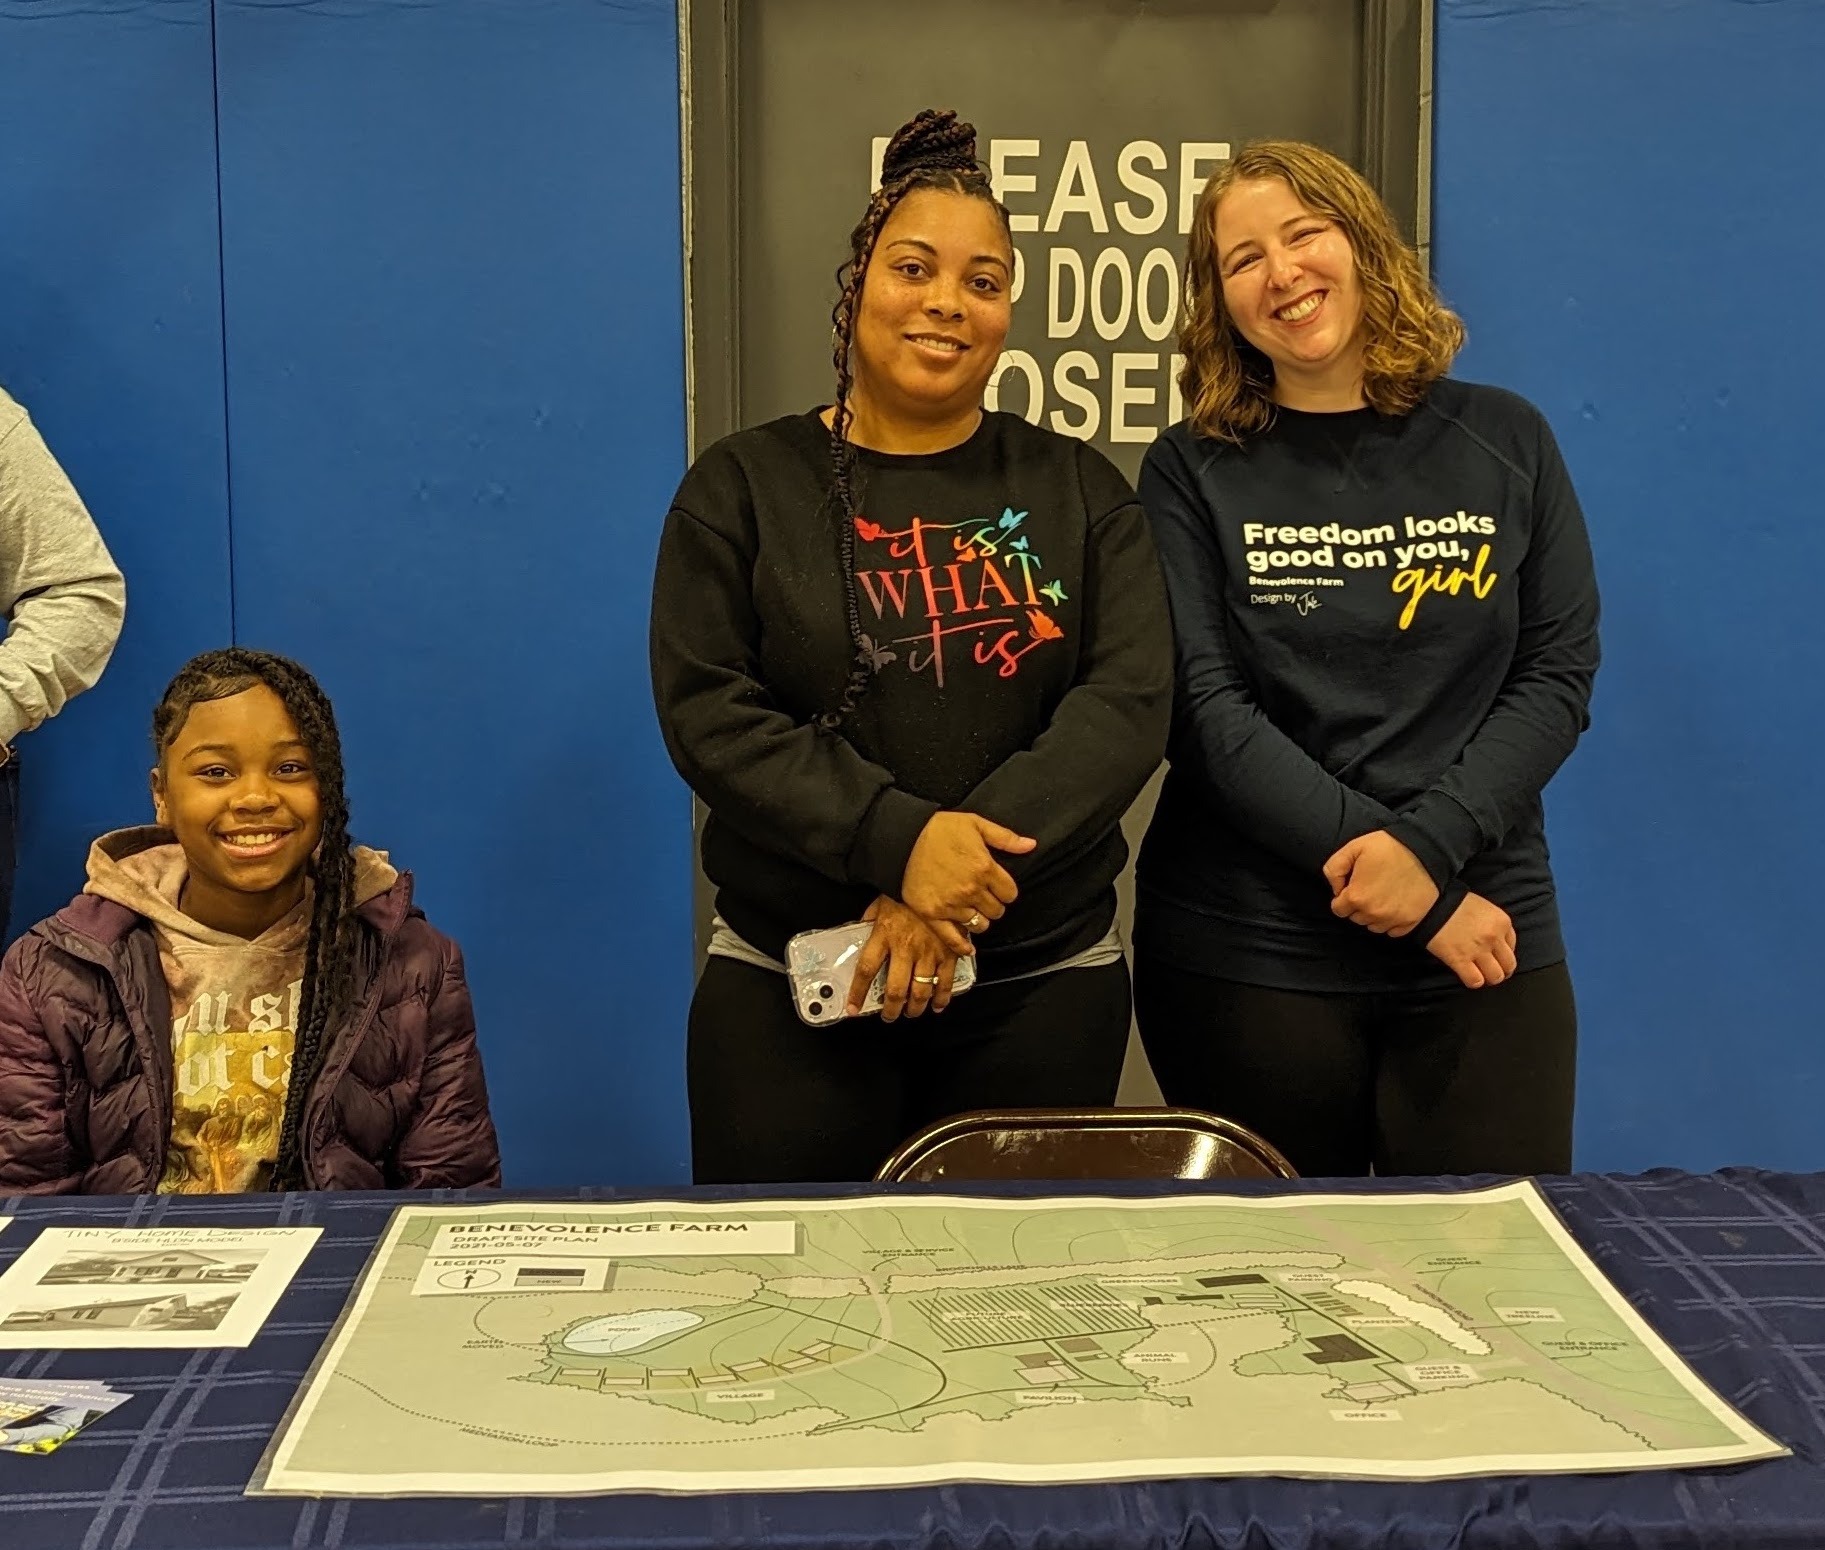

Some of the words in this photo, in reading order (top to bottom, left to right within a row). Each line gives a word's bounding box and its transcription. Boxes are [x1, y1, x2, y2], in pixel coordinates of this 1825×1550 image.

[1048, 247, 1194, 341] DOO
[1243, 523, 1395, 546] Freedom
[1404, 511, 1496, 538] looks
[1246, 546, 1335, 572] good
[1342, 549, 1387, 569] on
[1394, 540, 1469, 568] you,
[855, 553, 1042, 619] WHAT
[1249, 576, 1315, 586] Benevolence
[1316, 577, 1344, 587] Farm
[1392, 544, 1497, 630] girl
[1250, 594, 1282, 604] Design
[1284, 593, 1297, 604] by
[974, 630, 1031, 677] is
[64, 1229, 121, 1238] TINY
[137, 1229, 198, 1237] HOME
[207, 1229, 297, 1237] DESIGN
[449, 1224, 661, 1234] BENEVOLENCE
[670, 1224, 748, 1233] FARM
[453, 1235, 511, 1243] DRAFT
[434, 1259, 506, 1267] LEGEND
